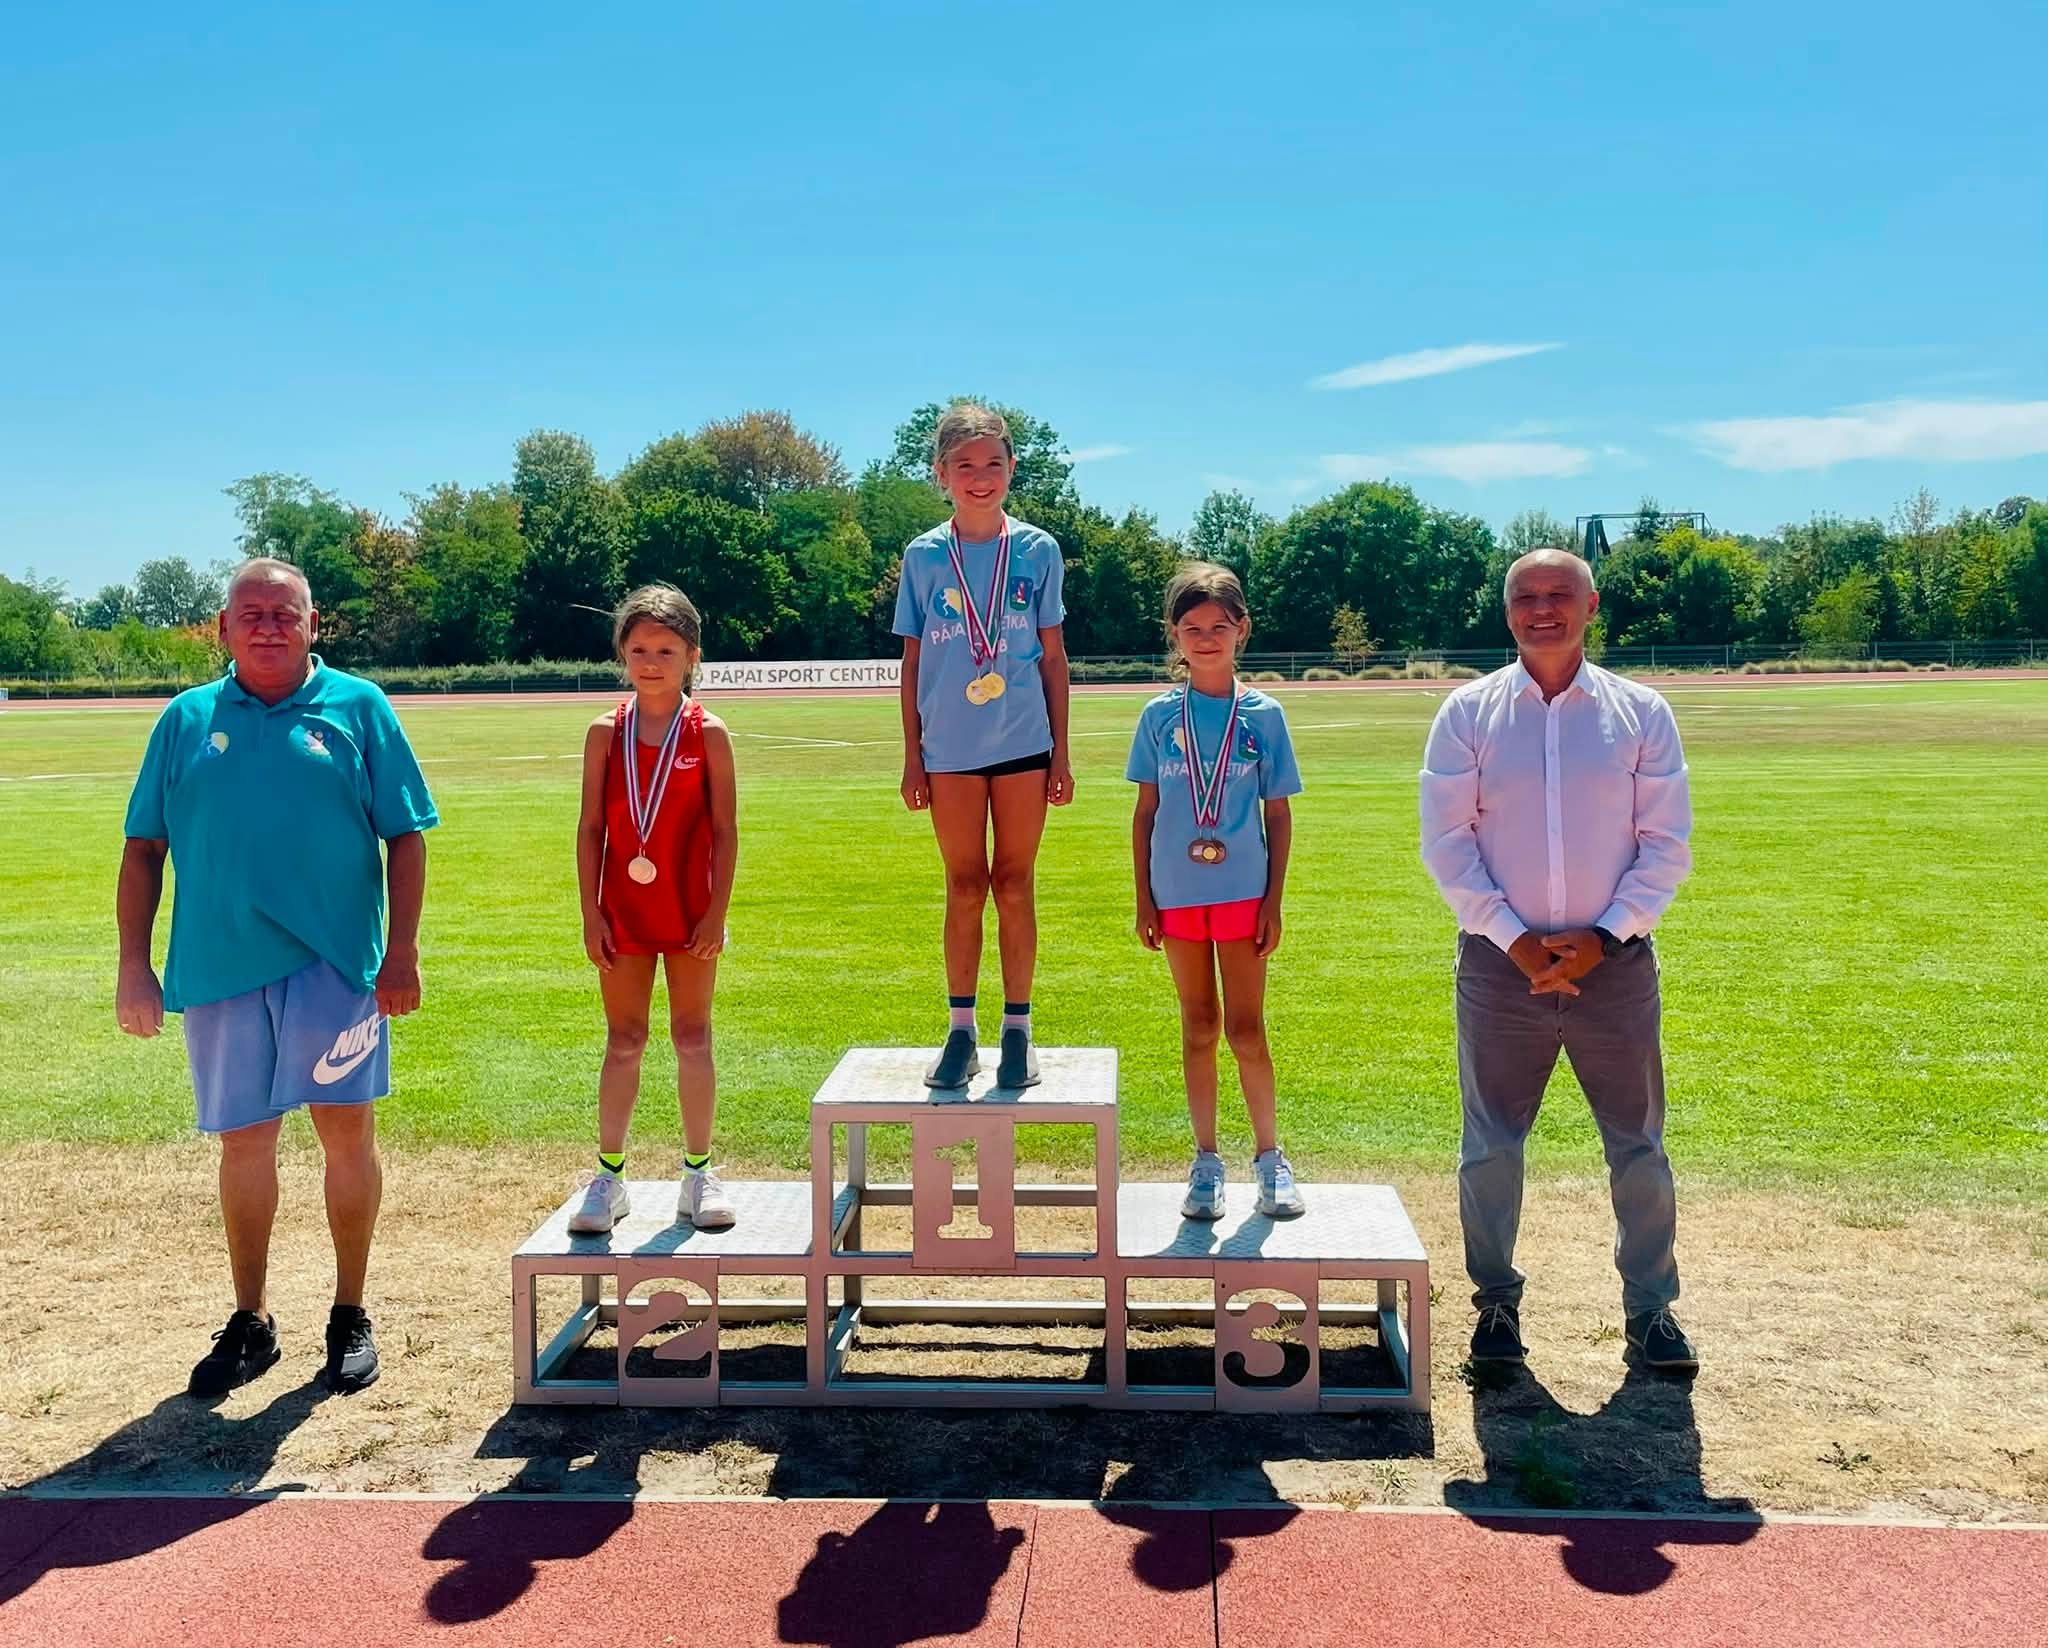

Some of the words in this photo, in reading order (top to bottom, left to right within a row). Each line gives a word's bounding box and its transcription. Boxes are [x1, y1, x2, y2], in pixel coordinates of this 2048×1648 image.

[711, 666, 763, 684] PÁPAI
[768, 668, 824, 683] SPORT
[830, 667, 899, 682] CENTRU
[933, 1136, 994, 1239] 1
[624, 1277, 713, 1379] 2
[1222, 1288, 1311, 1391] 3
